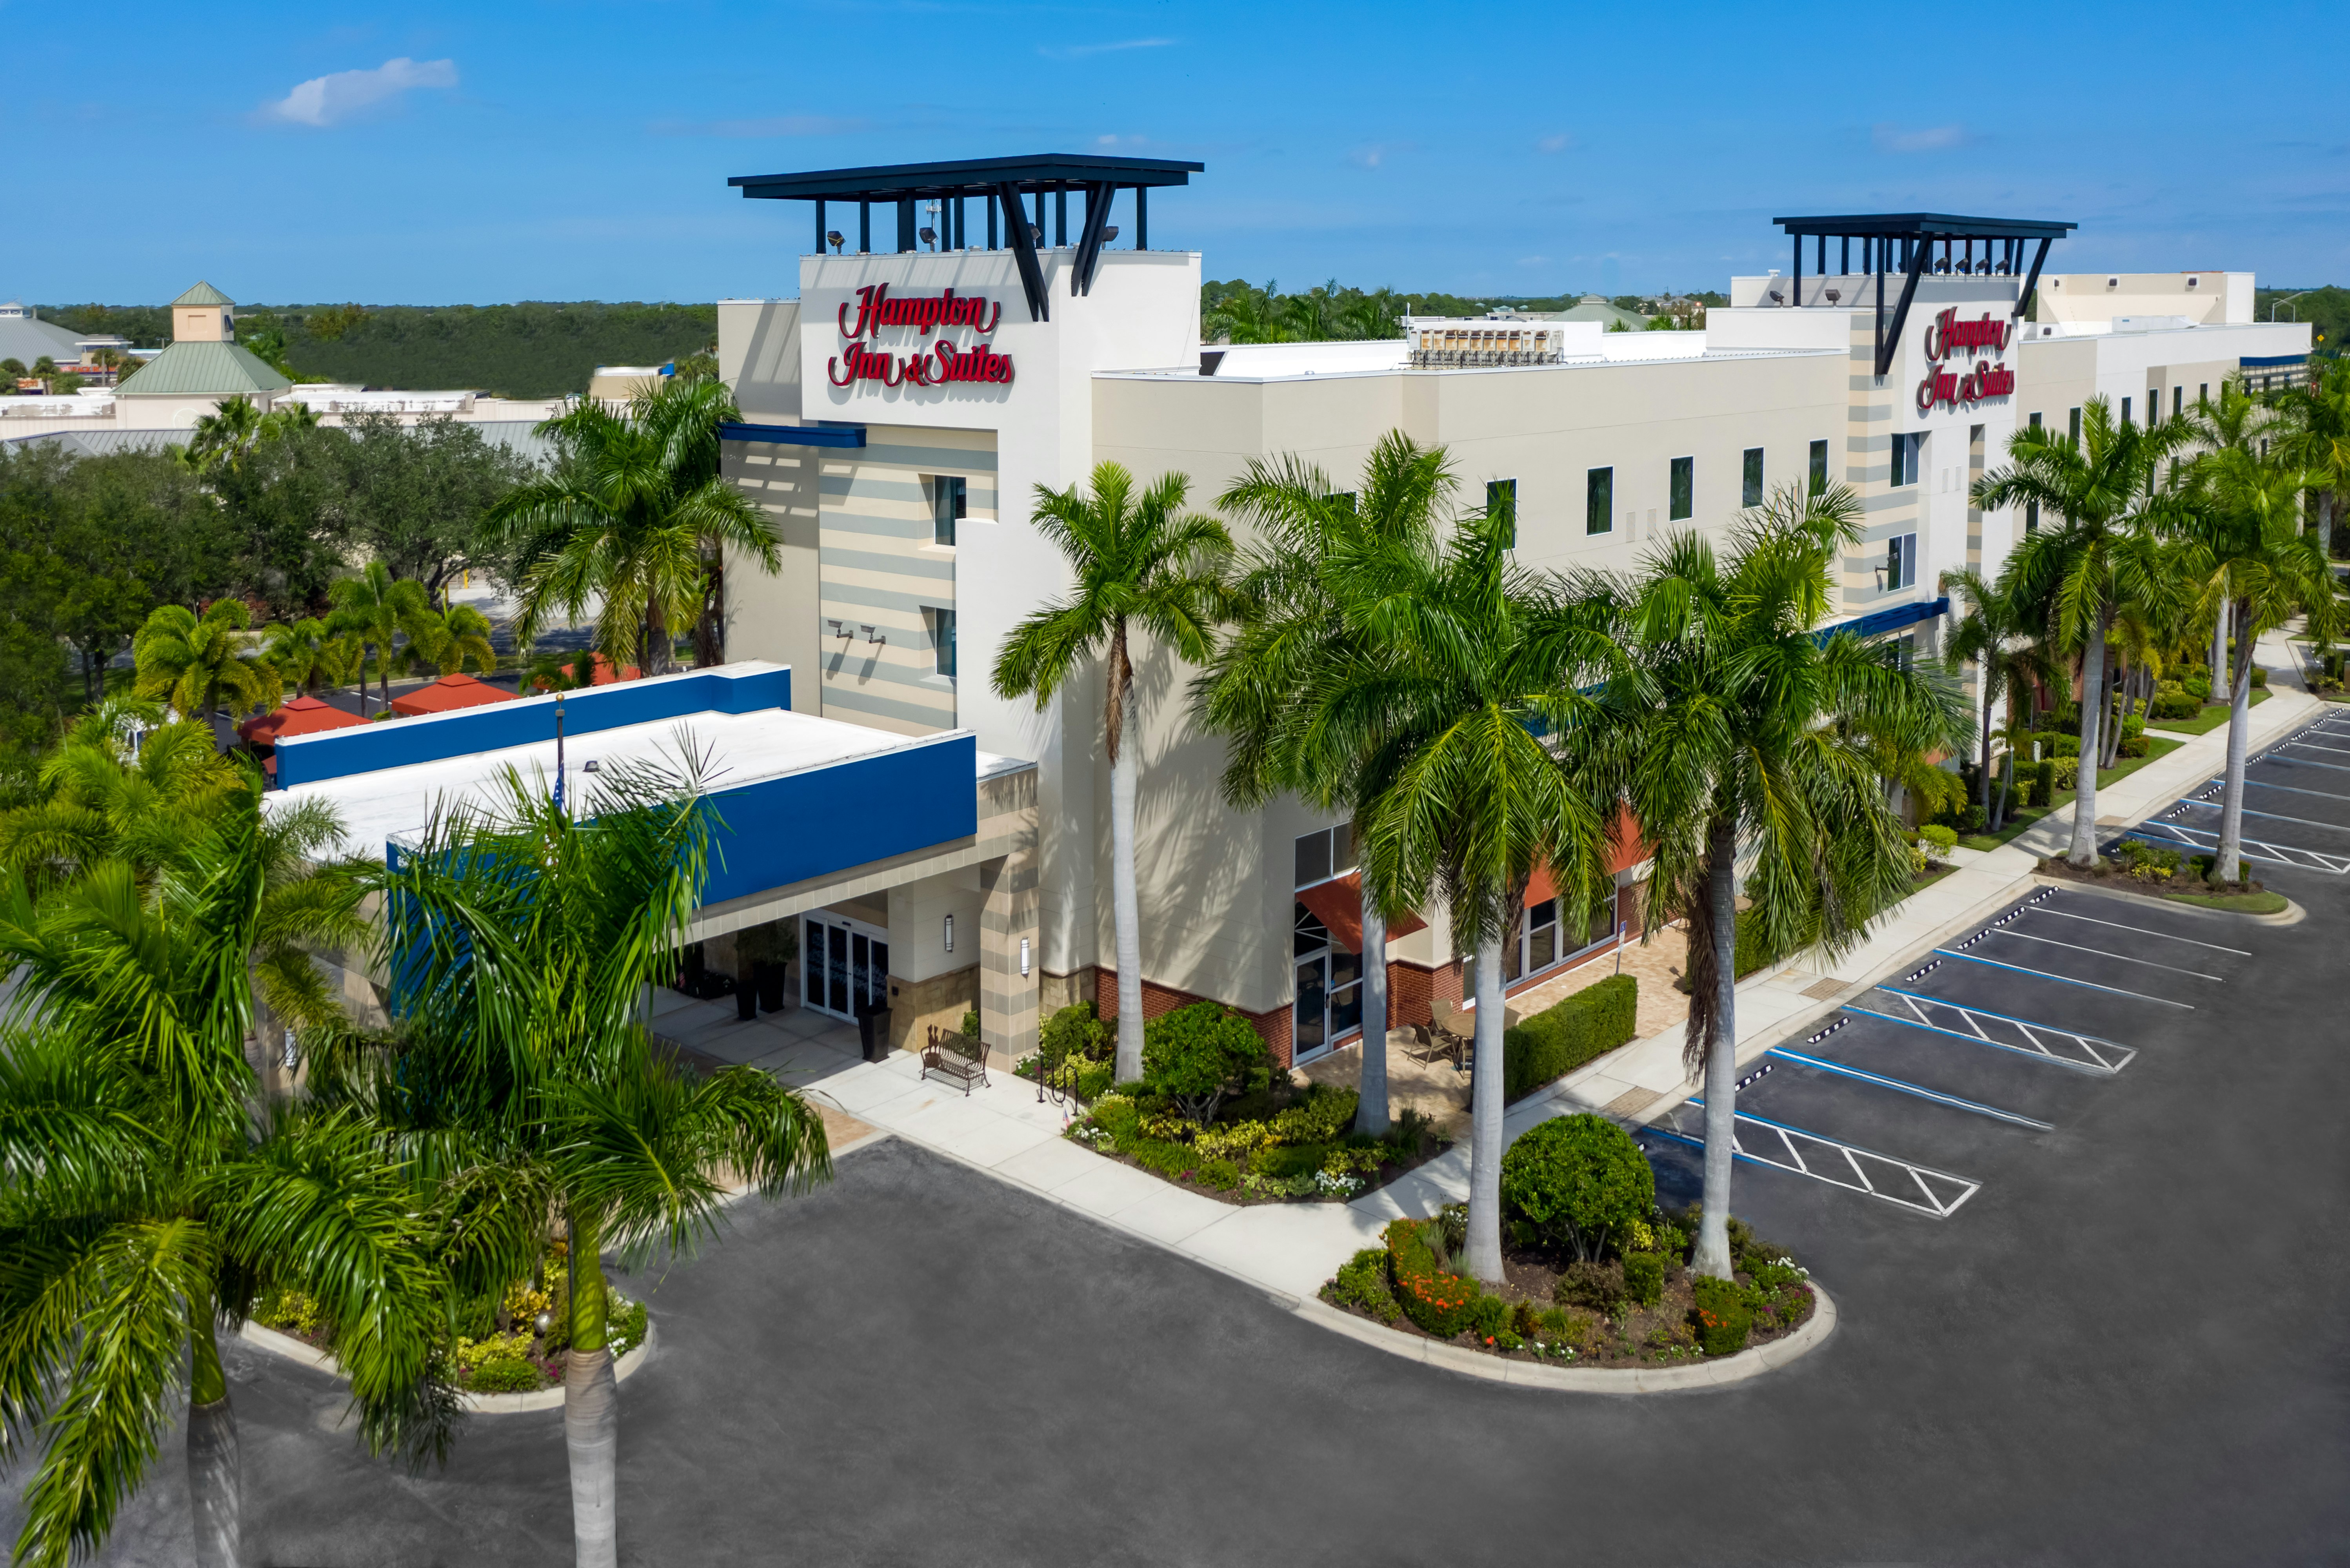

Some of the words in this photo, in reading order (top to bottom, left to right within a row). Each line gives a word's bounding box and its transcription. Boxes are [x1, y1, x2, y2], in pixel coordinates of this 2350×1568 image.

[838, 282, 1001, 339] Hampton
[1924, 306, 2012, 361] Hampton
[828, 341, 905, 387] Inn
[905, 353, 930, 387] &
[923, 339, 1016, 384] Suites
[1917, 364, 1966, 409] Inn
[1972, 360, 2015, 400] Suites
